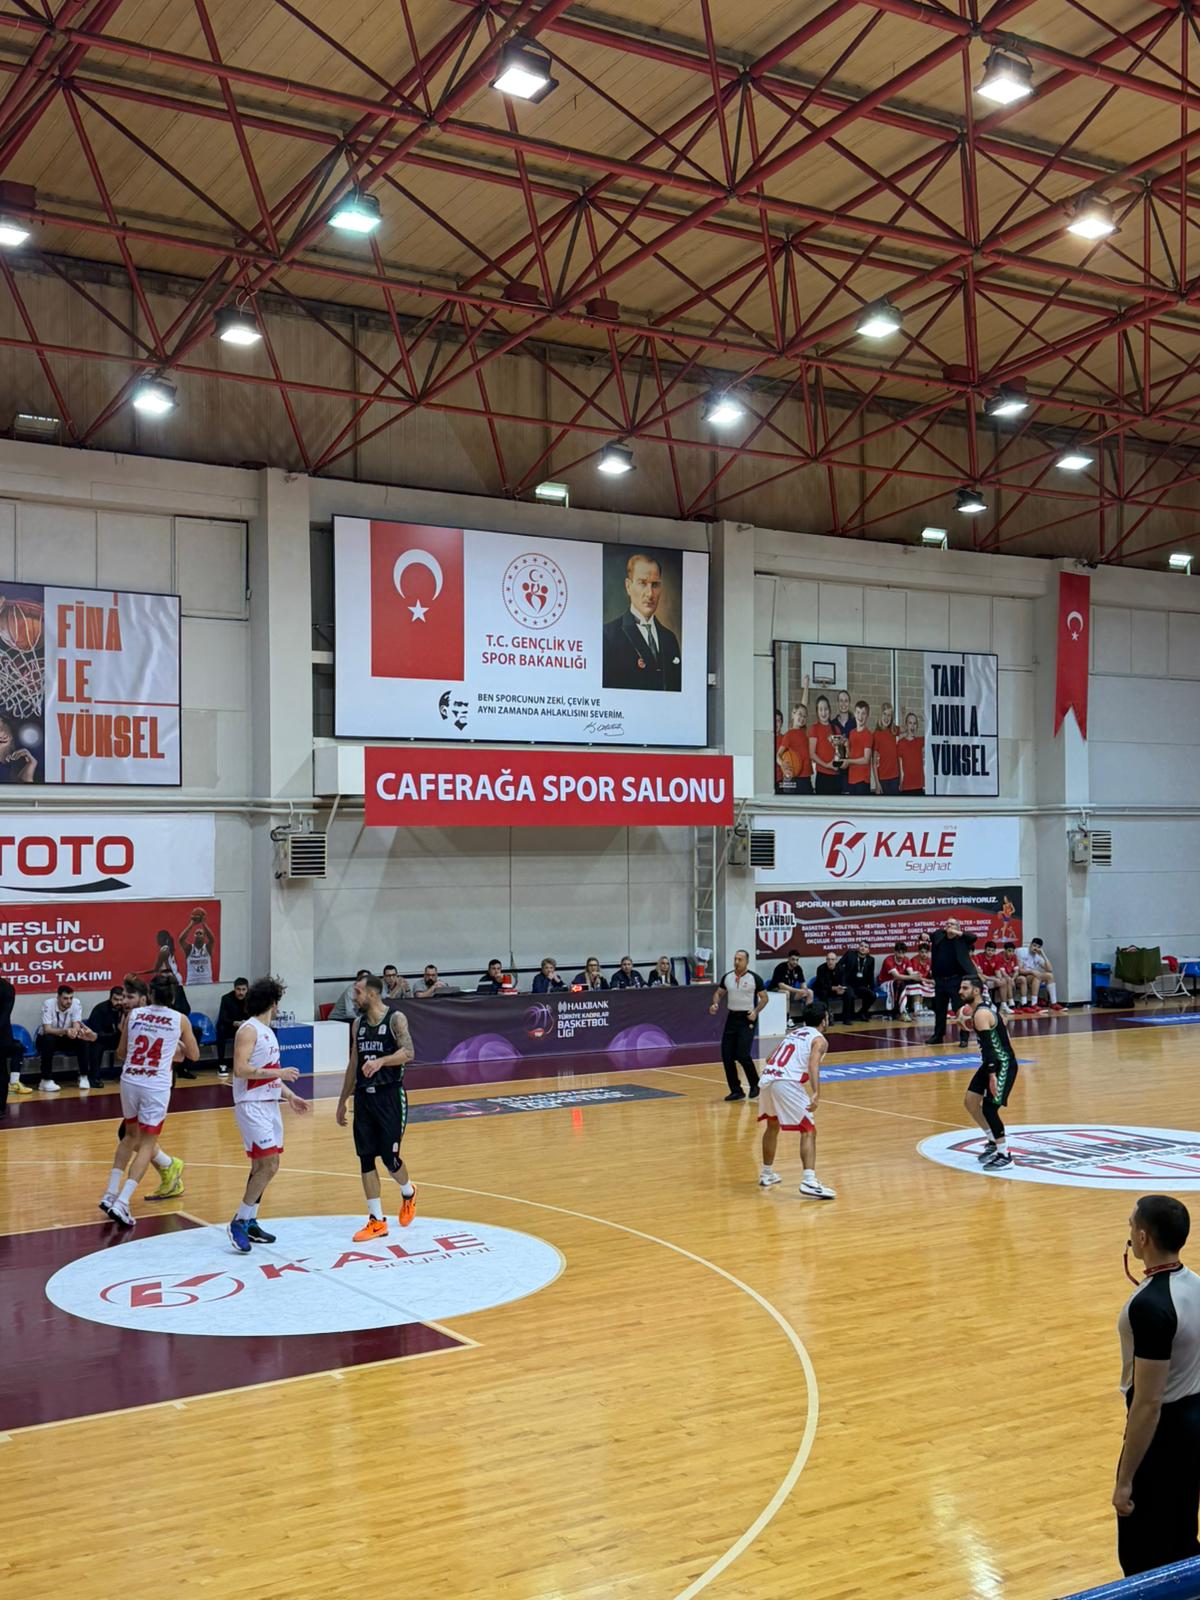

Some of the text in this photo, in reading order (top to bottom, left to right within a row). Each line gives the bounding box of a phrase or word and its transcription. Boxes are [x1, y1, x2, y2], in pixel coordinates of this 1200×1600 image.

[486, 634, 583, 653] T.C. GENÇLİK VE
[482, 652, 587, 669] SPOR BAKANLIĞI
[57, 658, 92, 703] LE
[477, 693, 493, 702] BEN
[495, 693, 546, 704] SPORCUNUN
[567, 696, 590, 708] ÇEVİK
[591, 698, 601, 707] VE
[477, 705, 625, 719] AYNI ZAMANDA AHLAKLISINI SEVERİM.
[931, 704, 979, 737] MINLA
[57, 709, 165, 759] YÜKSEL
[931, 740, 990, 777] YÜKSEL
[376, 769, 726, 803] CAFERAĞA SPOR SALONU
[873, 832, 957, 858] KALE
[905, 860, 952, 873] Seyahat
[796, 900, 830, 909] SPORUN
[831, 900, 849, 908] HER
[850, 898, 895, 908] BRANŞINDA
[897, 896, 936, 906] GELECEĞİ
[756, 912, 795, 926] İSTANBUL
[0, 934, 104, 955] Kİ GÜCÜ
[0, 960, 64, 972] UL GSK
[0, 971, 112, 985] TBOL TAKIMI
[568, 1001, 609, 1010] HALKBANK
[558, 1018, 609, 1029] BASKETBOL
[131, 1034, 164, 1068] 24
[259, 1233, 485, 1279] KALE
